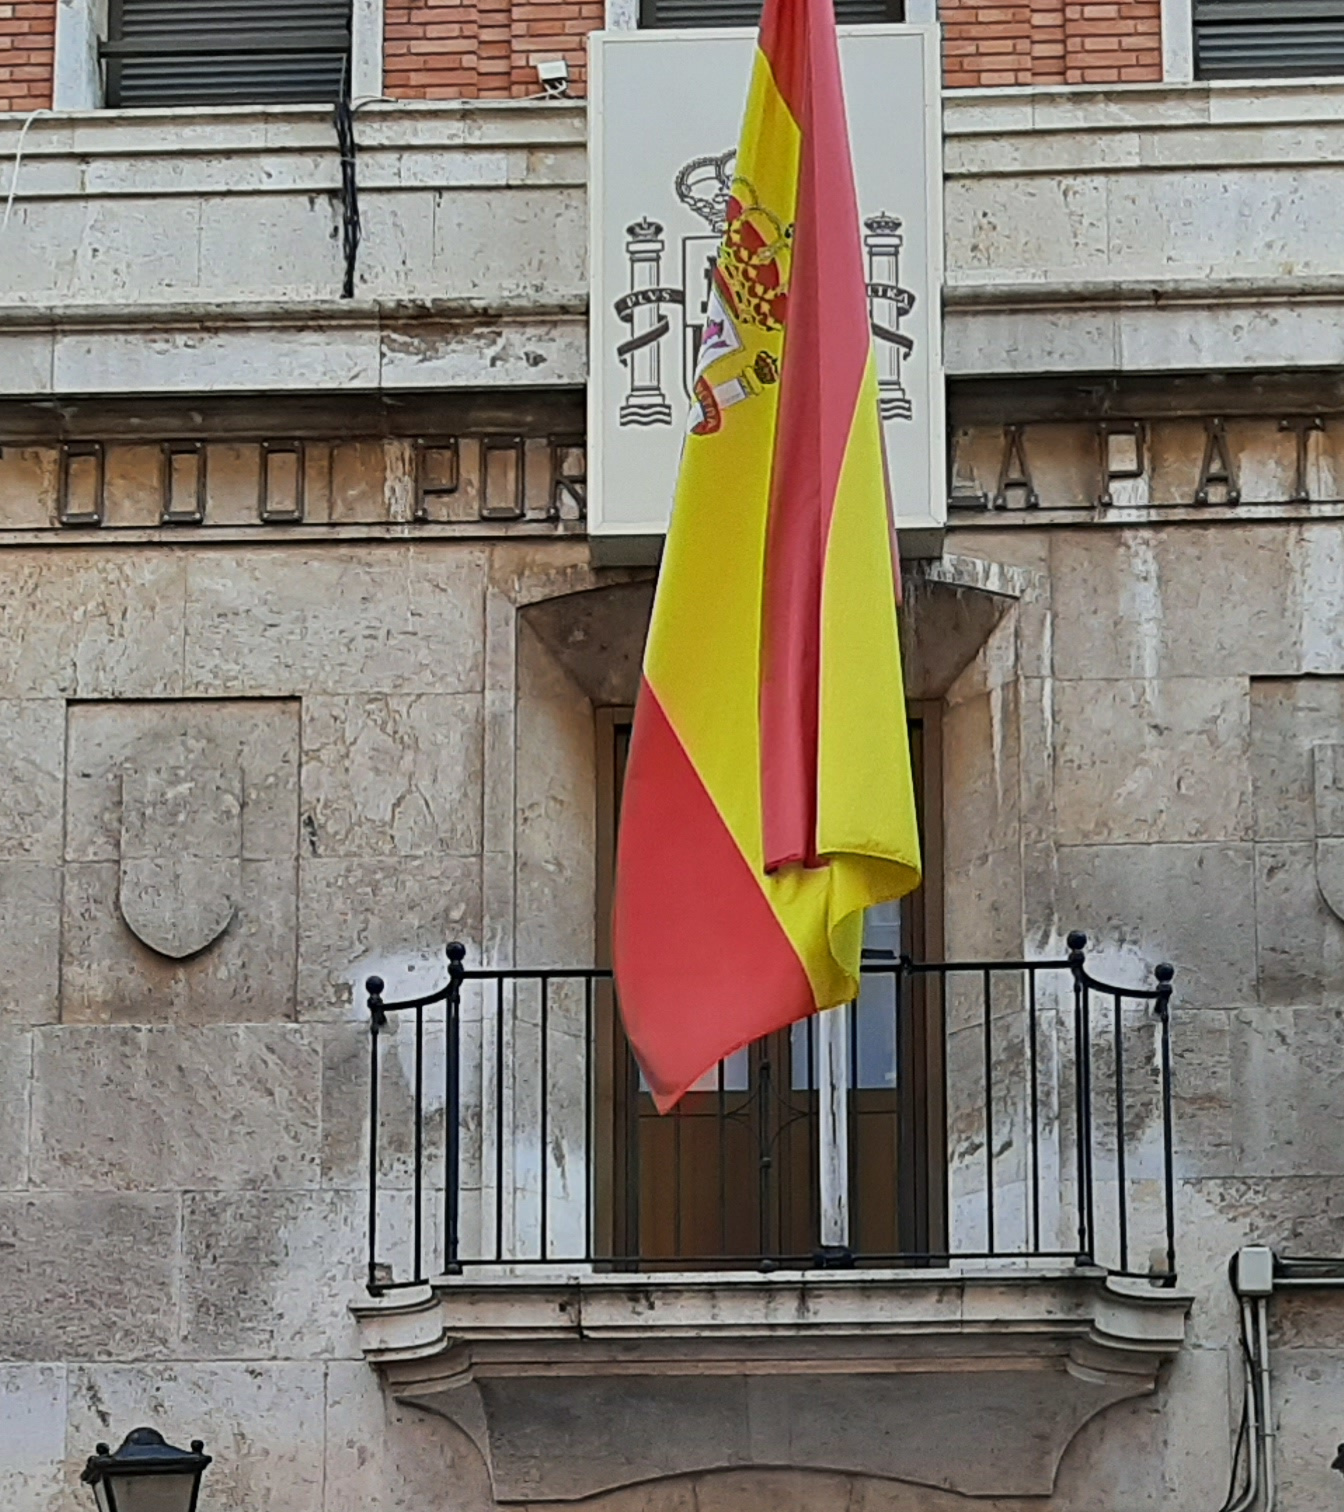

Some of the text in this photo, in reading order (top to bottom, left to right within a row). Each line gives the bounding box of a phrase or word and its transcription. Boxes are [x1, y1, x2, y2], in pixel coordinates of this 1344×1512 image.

[625, 289, 672, 307] PLVS
[867, 285, 911, 307] LTRA
[414, 433, 588, 524] POR
